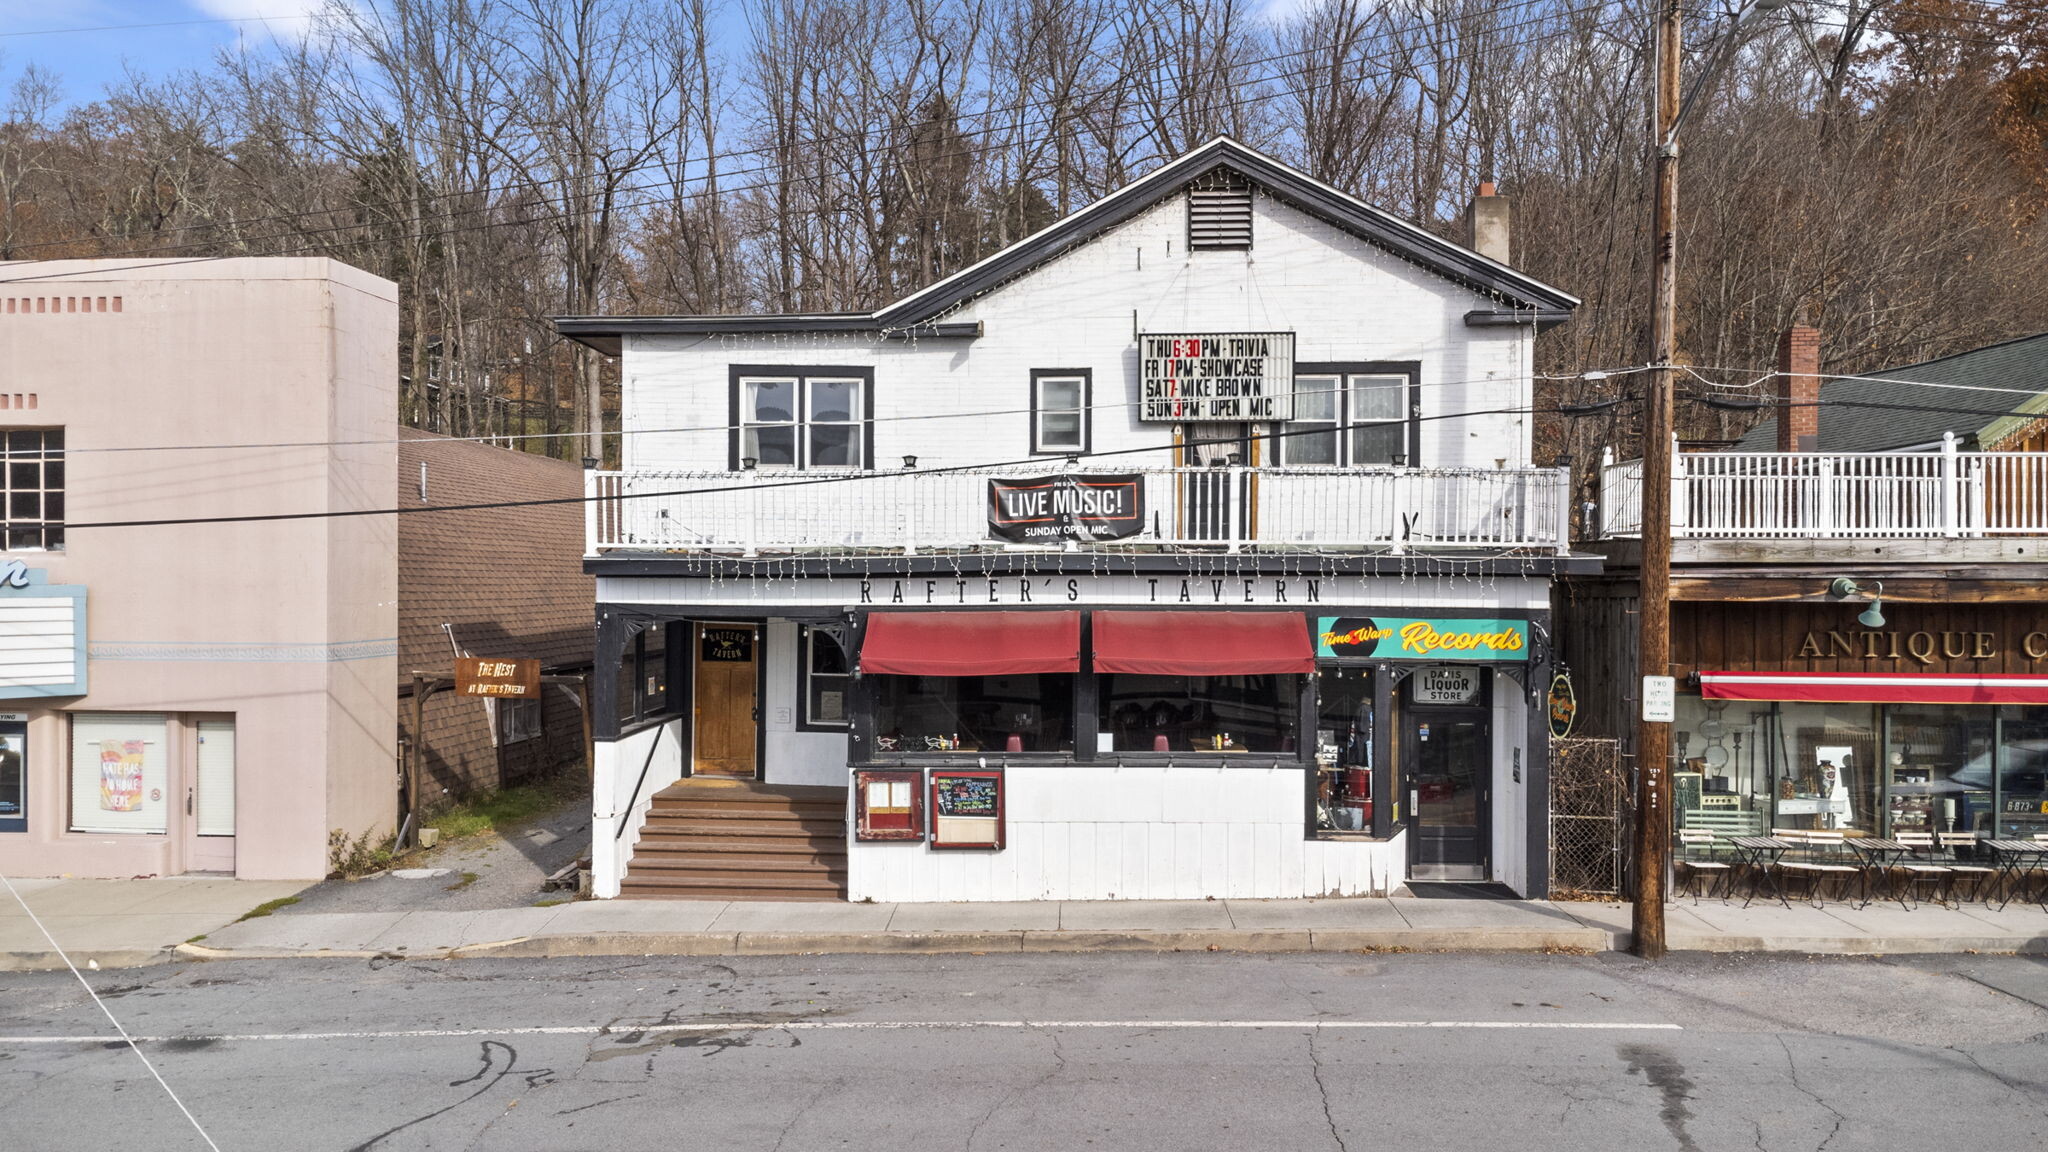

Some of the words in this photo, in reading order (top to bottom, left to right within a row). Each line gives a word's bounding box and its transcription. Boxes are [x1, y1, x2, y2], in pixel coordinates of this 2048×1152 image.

[1148, 339, 1171, 358] THU
[1229, 338, 1269, 357] TRIVIA
[1200, 358, 1263, 377] SHOWCASE
[1146, 379, 1170, 397] SAT
[1181, 379, 1211, 397] MIKE
[1216, 378, 1261, 397] BROWN
[1148, 399, 1172, 417] SUN
[1211, 399, 1240, 417] OPEN
[1250, 398, 1272, 417] MIC
[1008, 491, 1047, 517] LIVE
[1053, 489, 1122, 514] MUSIC!
[1025, 525, 1062, 537] SUNDAY
[1063, 525, 1089, 536] OPEN
[1091, 525, 1108, 535] MIC
[860, 579, 1079, 603] RAFTER'S
[1148, 579, 1319, 602] TAVERN
[1320, 632, 1352, 647] Time
[1354, 626, 1393, 642] Warp
[1399, 621, 1523, 654] Records
[712, 647, 742, 659] TAVERN
[1798, 631, 1996, 664] ANTIQUE
[493, 662, 516, 677] NEST
[503, 684, 526, 694] TAVERN
[1424, 676, 1469, 691] LIQUOR
[1430, 691, 1462, 700] STORE
[123, 762, 140, 775] HAS
